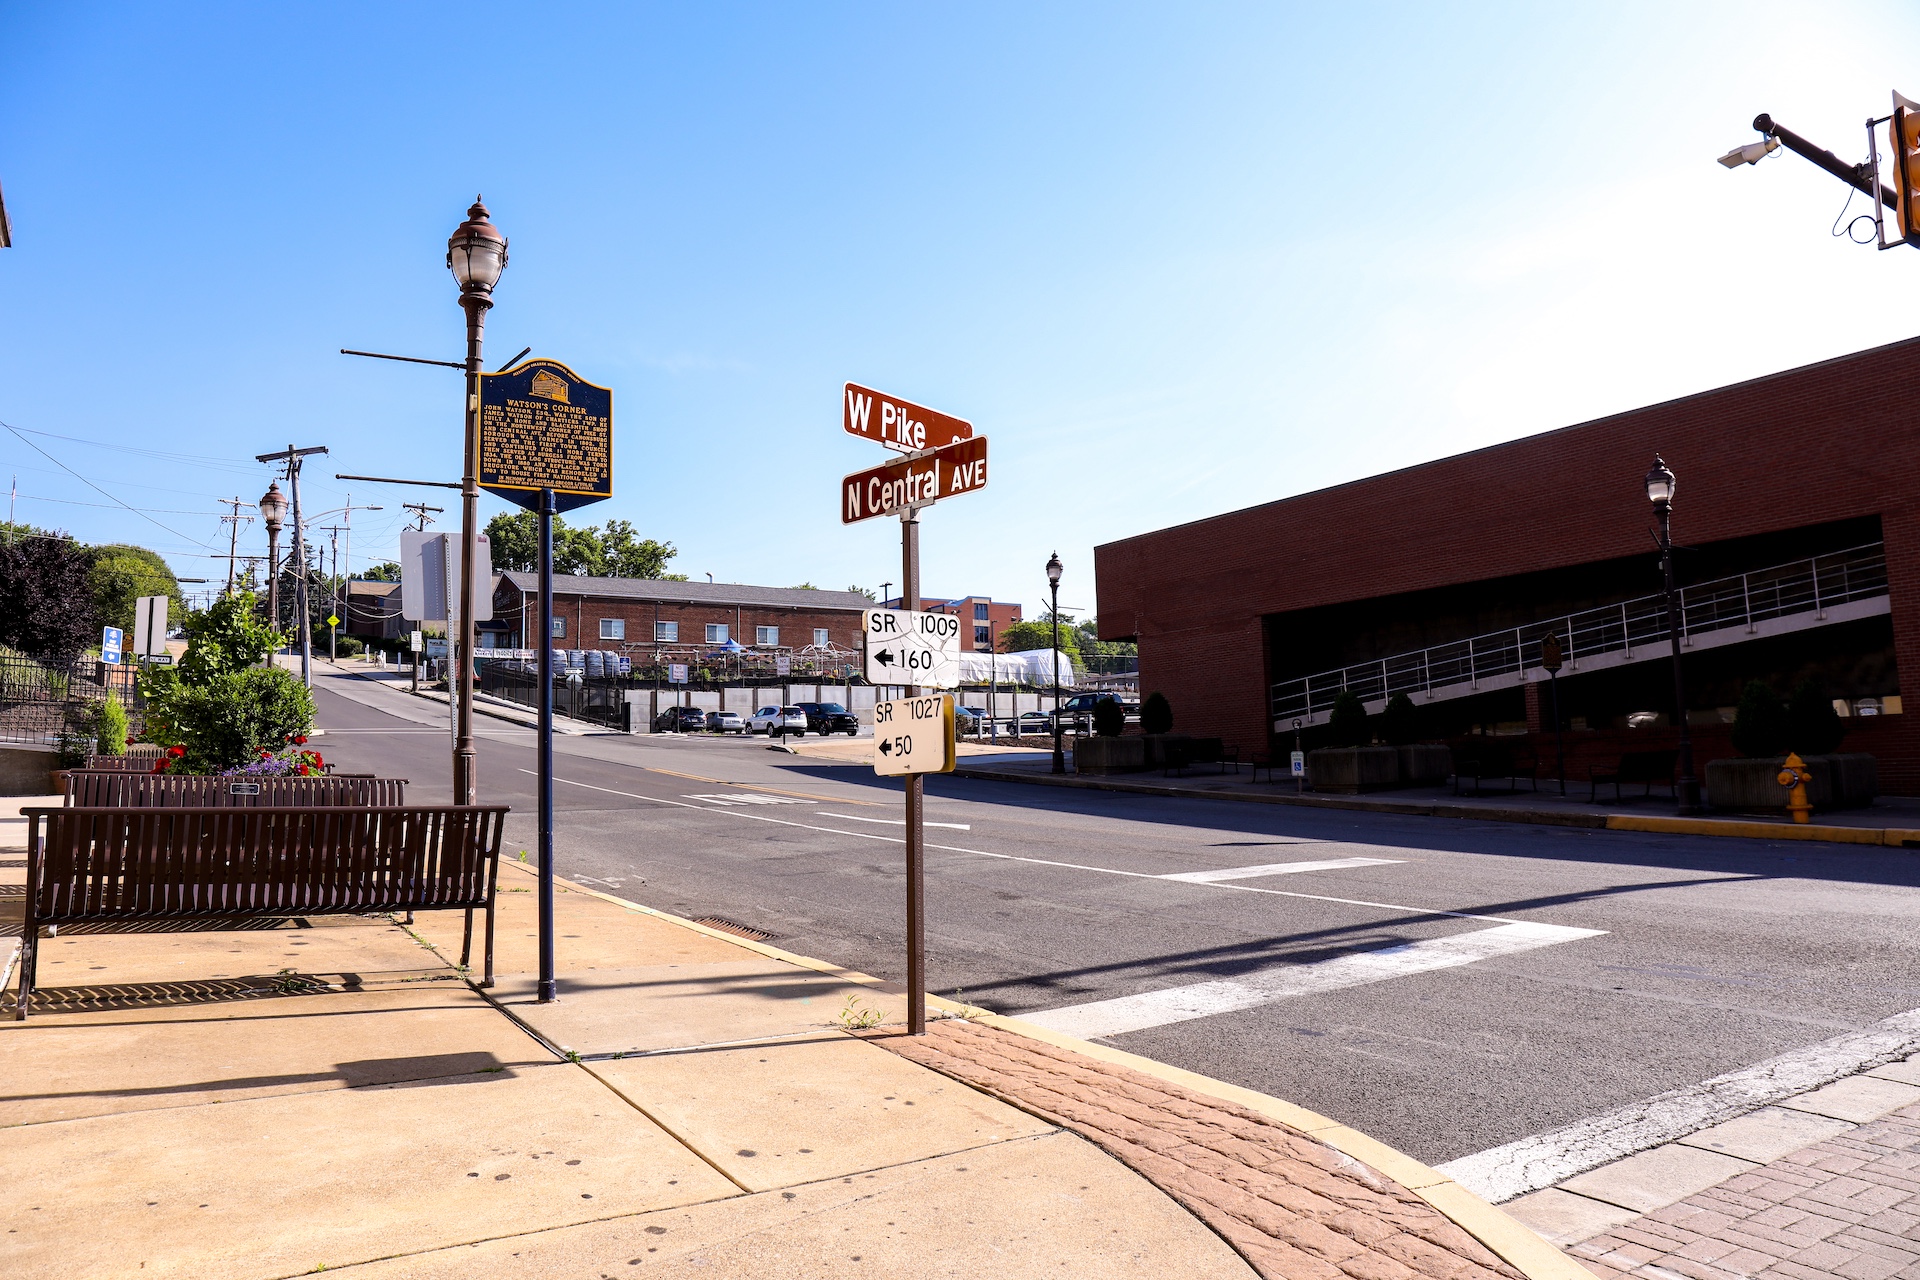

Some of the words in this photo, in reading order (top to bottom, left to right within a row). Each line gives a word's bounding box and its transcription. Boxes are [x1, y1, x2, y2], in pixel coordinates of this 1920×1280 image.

[507, 399, 548, 410] WATSON'S
[552, 405, 587, 414] CORNER
[551, 422, 588, 430] BLACKSMITH
[847, 390, 872, 432] W
[881, 401, 926, 450] Pike
[484, 431, 514, 439] BOROUGH
[501, 443, 536, 451] CONTINUED
[848, 482, 861, 520] N
[868, 459, 940, 514] Central
[951, 459, 985, 492] AVE
[871, 613, 896, 633] SR
[920, 615, 958, 637] 1009
[900, 650, 932, 669] 160
[876, 703, 893, 723] SR
[910, 697, 941, 720] 1027
[895, 735, 912, 757] 50
